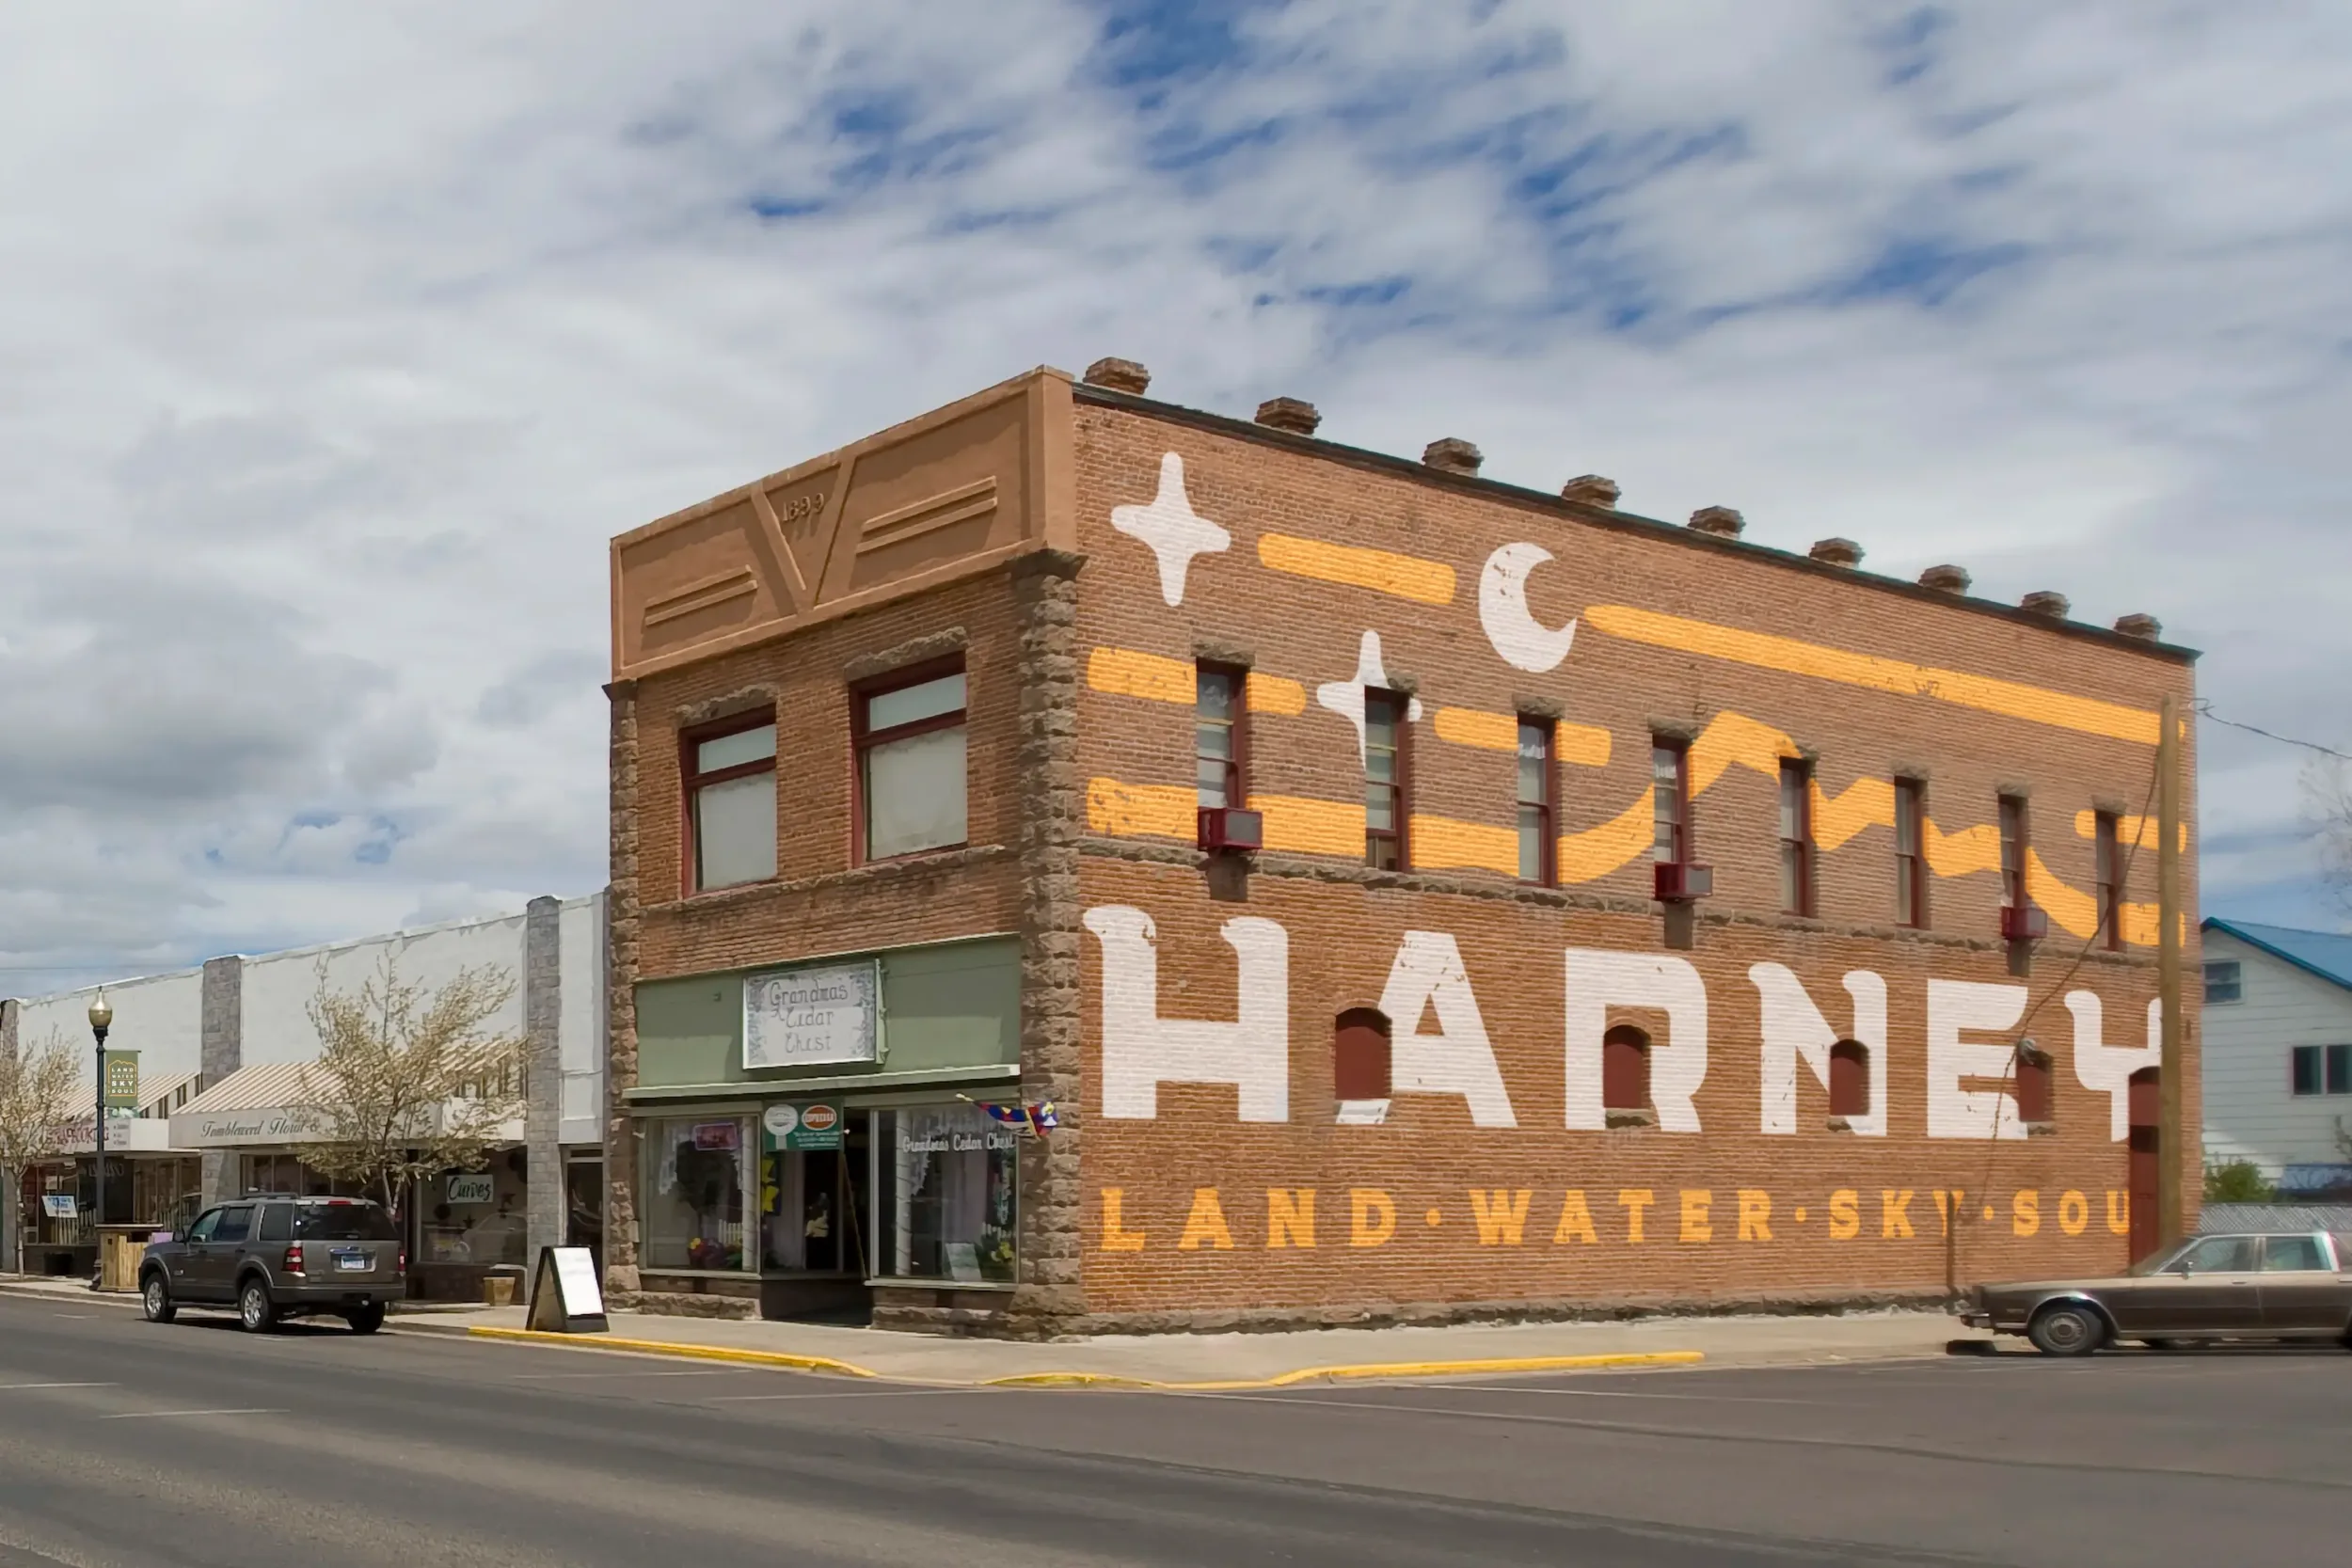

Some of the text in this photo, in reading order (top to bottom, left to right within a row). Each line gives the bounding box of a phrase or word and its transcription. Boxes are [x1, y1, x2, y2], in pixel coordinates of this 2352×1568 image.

[1082, 904, 2162, 1142] HARNEY
[1101, 1187, 2130, 1251] LAND WATER SKY SOU
